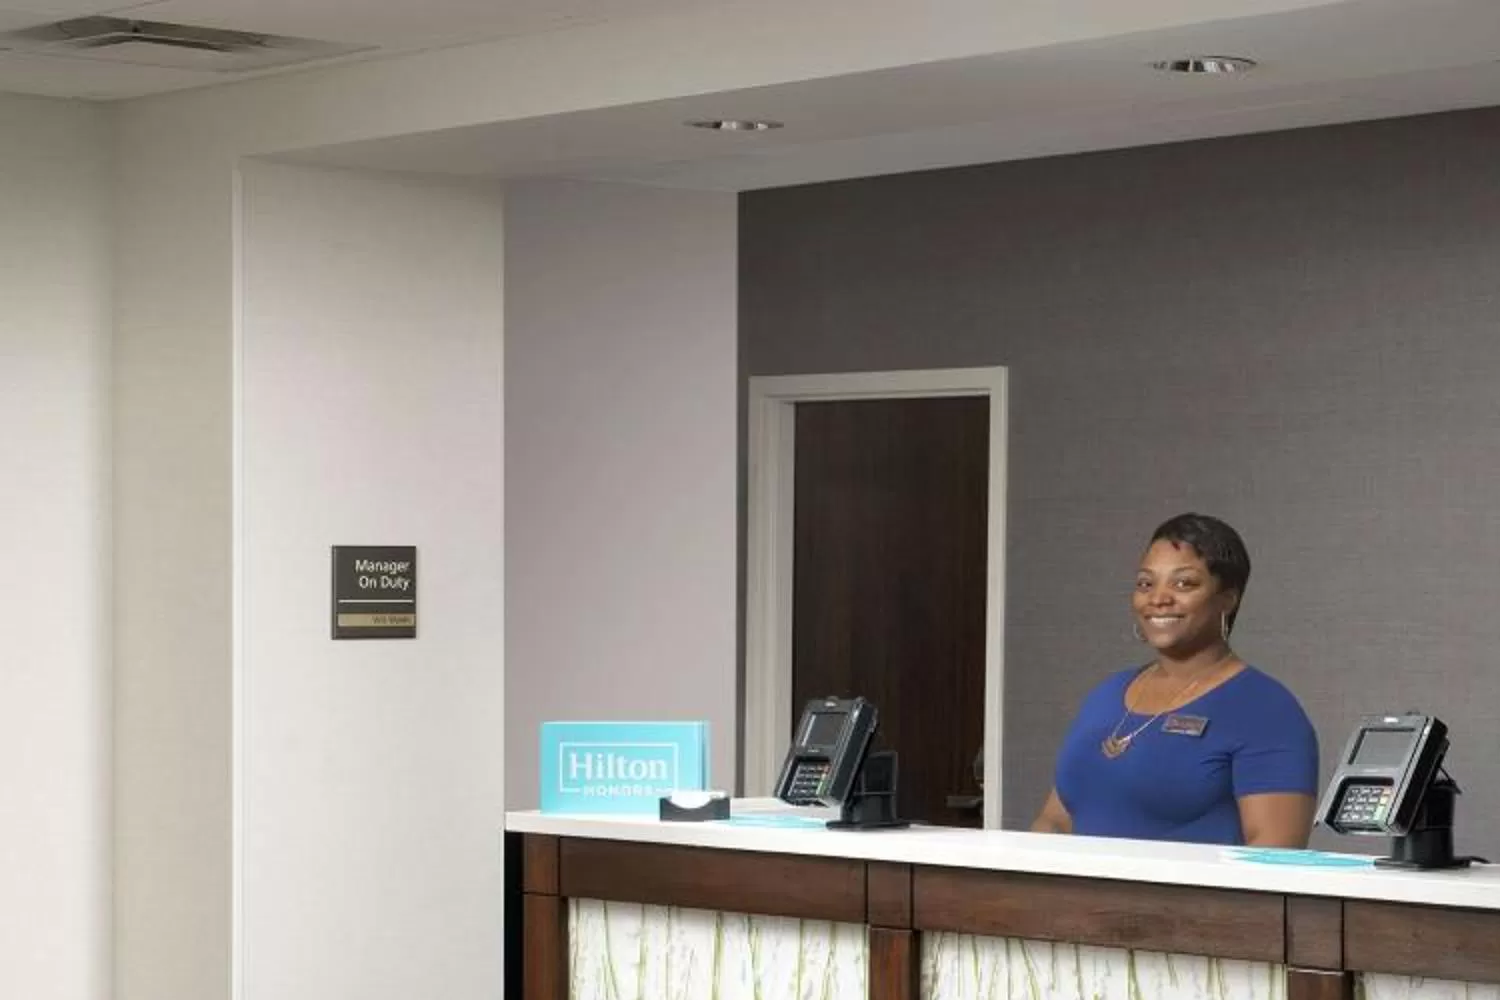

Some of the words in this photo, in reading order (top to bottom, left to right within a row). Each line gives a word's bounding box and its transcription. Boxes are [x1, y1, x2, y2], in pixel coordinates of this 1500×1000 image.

[355, 560, 411, 574] Manager
[359, 576, 377, 588] On
[381, 576, 411, 591] Duty
[569, 752, 669, 781] Hilton
